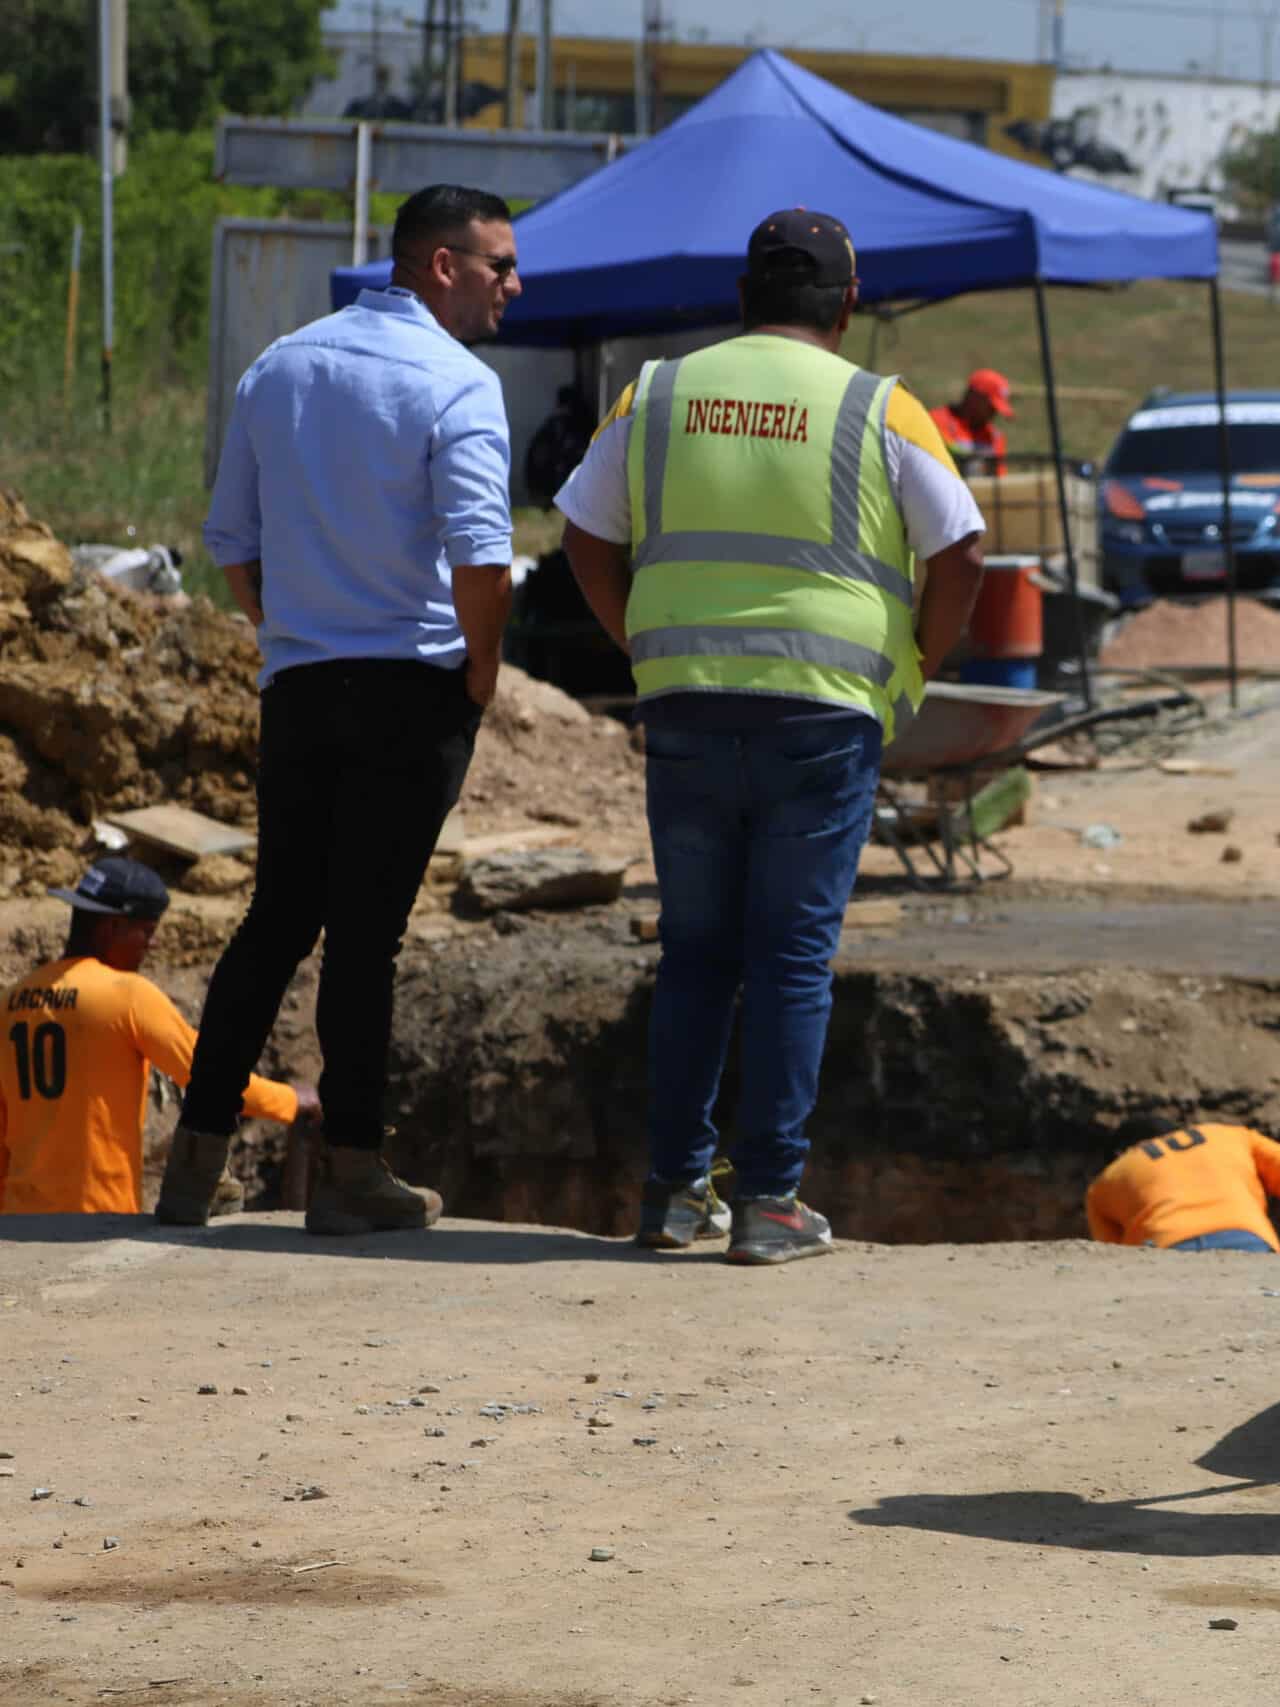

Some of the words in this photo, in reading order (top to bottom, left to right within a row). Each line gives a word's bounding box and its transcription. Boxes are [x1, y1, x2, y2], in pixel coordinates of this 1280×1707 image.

[685, 398, 808, 443] INGENIERÍA
[8, 987, 79, 1011] LACAVA
[9, 1021, 67, 1100] 10
